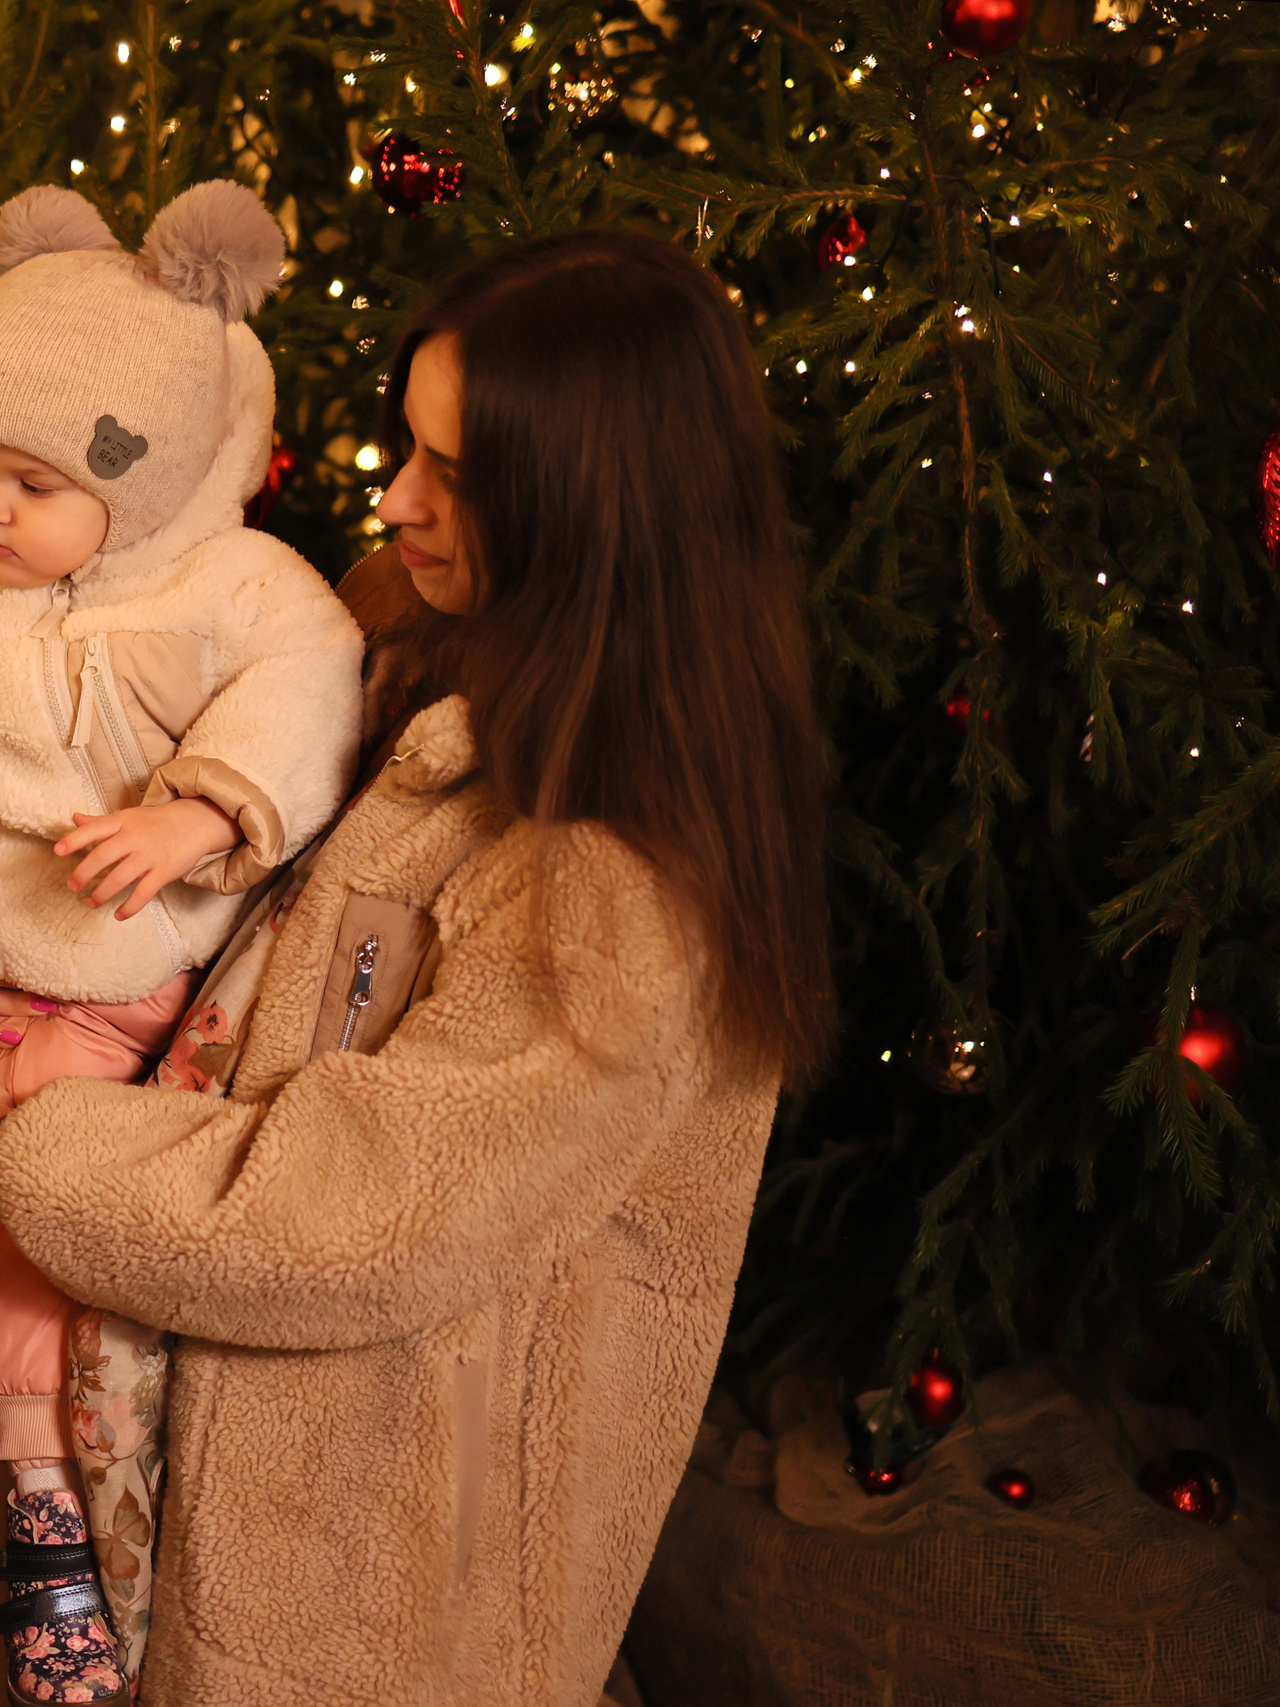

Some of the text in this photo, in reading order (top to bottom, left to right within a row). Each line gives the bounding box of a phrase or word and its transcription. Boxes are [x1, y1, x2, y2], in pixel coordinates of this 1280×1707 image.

[97, 448, 118, 468] BEAR
[102, 435, 133, 460] MY LITTLE
